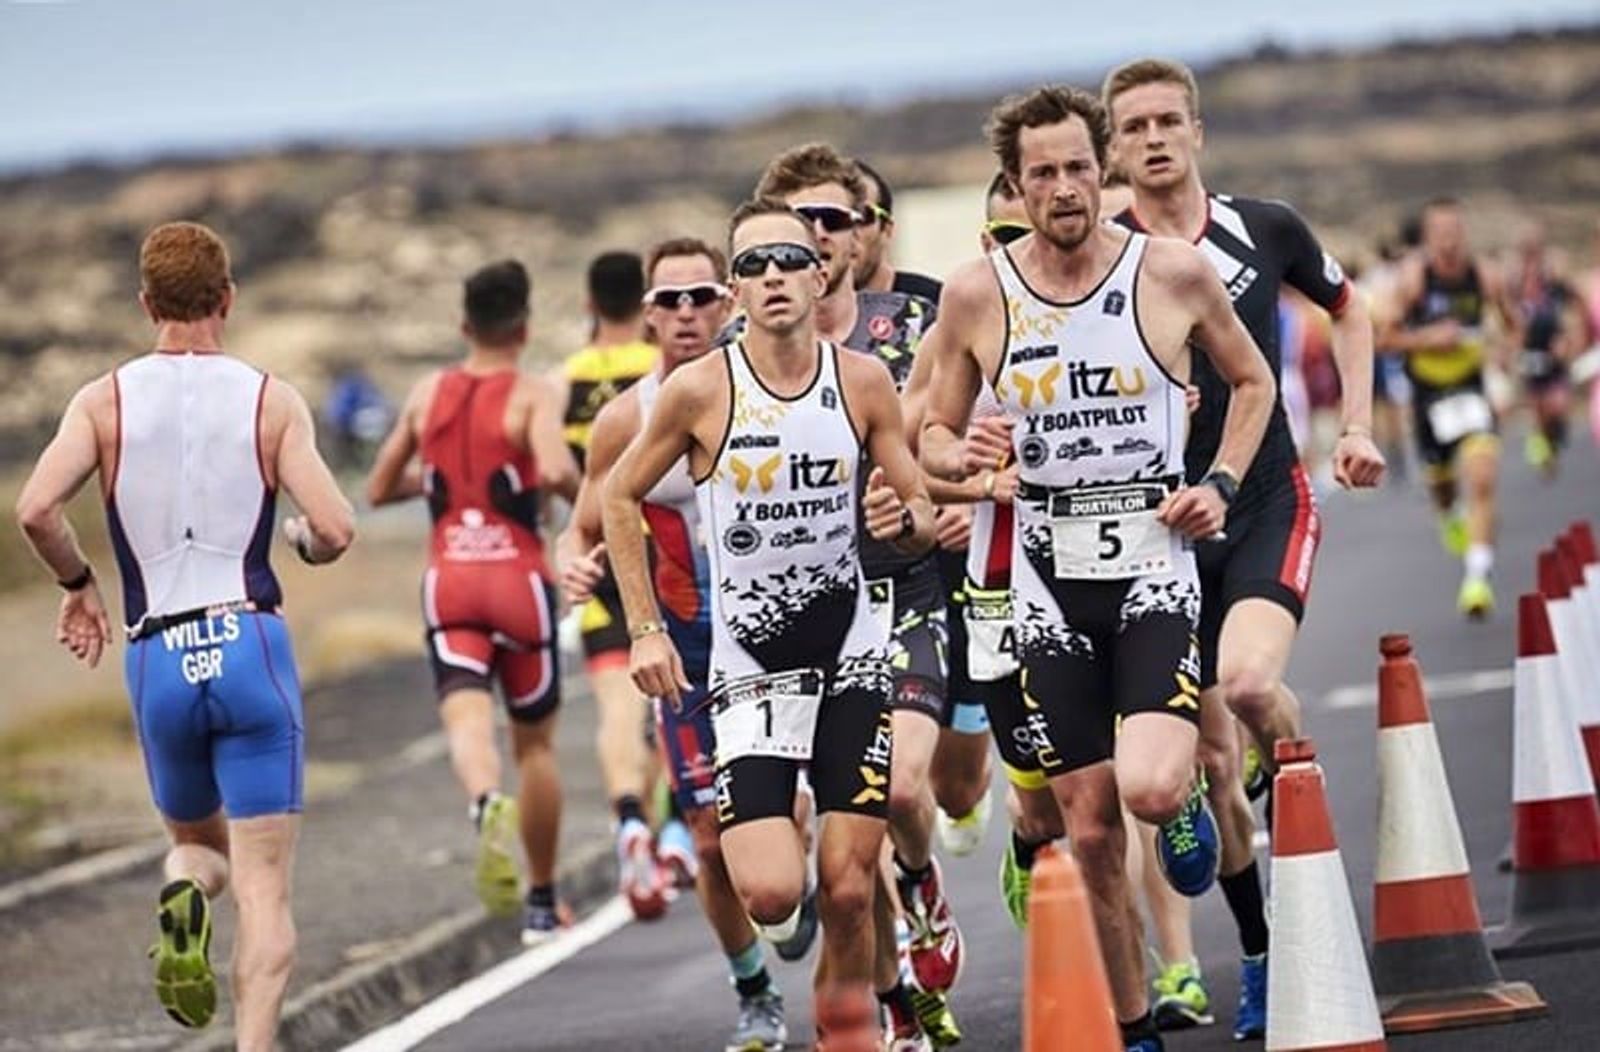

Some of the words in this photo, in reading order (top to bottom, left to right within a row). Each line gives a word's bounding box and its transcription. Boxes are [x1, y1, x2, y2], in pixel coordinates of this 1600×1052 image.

[1068, 360, 1146, 399] itzu
[1043, 405, 1148, 432] BOATPILOT
[1070, 495, 1147, 515] DUATHLON
[1098, 520, 1123, 561] 5
[162, 613, 241, 651] WILLS
[182, 647, 224, 685] GBR
[755, 699, 774, 738] 1
